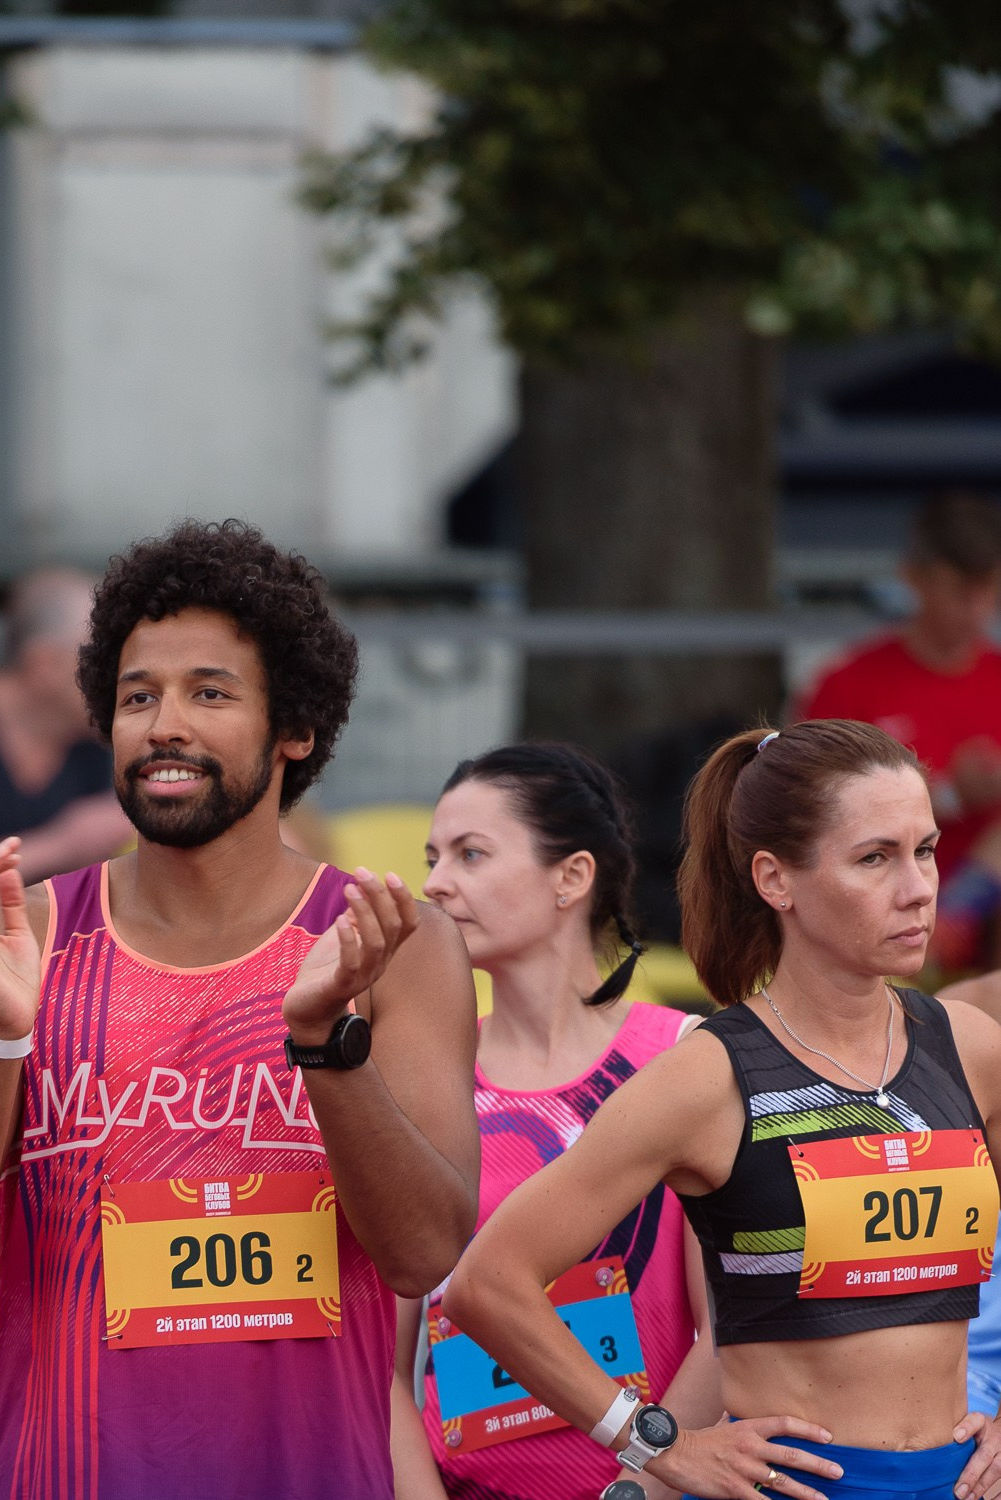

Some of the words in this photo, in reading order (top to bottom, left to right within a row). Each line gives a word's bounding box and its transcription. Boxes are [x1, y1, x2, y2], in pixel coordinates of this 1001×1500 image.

[21, 1062, 325, 1160] MyRUN
[864, 1185, 943, 1243] 207
[965, 1207, 979, 1234] 2
[170, 1231, 273, 1289] 206
[296, 1254, 314, 1283] 2
[846, 1270, 861, 1285] 2й
[863, 1269, 890, 1283] этап
[893, 1266, 917, 1281] 1200
[919, 1263, 958, 1281] метров
[156, 1316, 173, 1333] 2й
[176, 1317, 207, 1332] этап
[210, 1313, 241, 1330] 1200
[244, 1312, 293, 1328] метров
[599, 1335, 618, 1363] 3
[485, 1415, 501, 1432] 3й
[502, 1410, 531, 1428] этап
